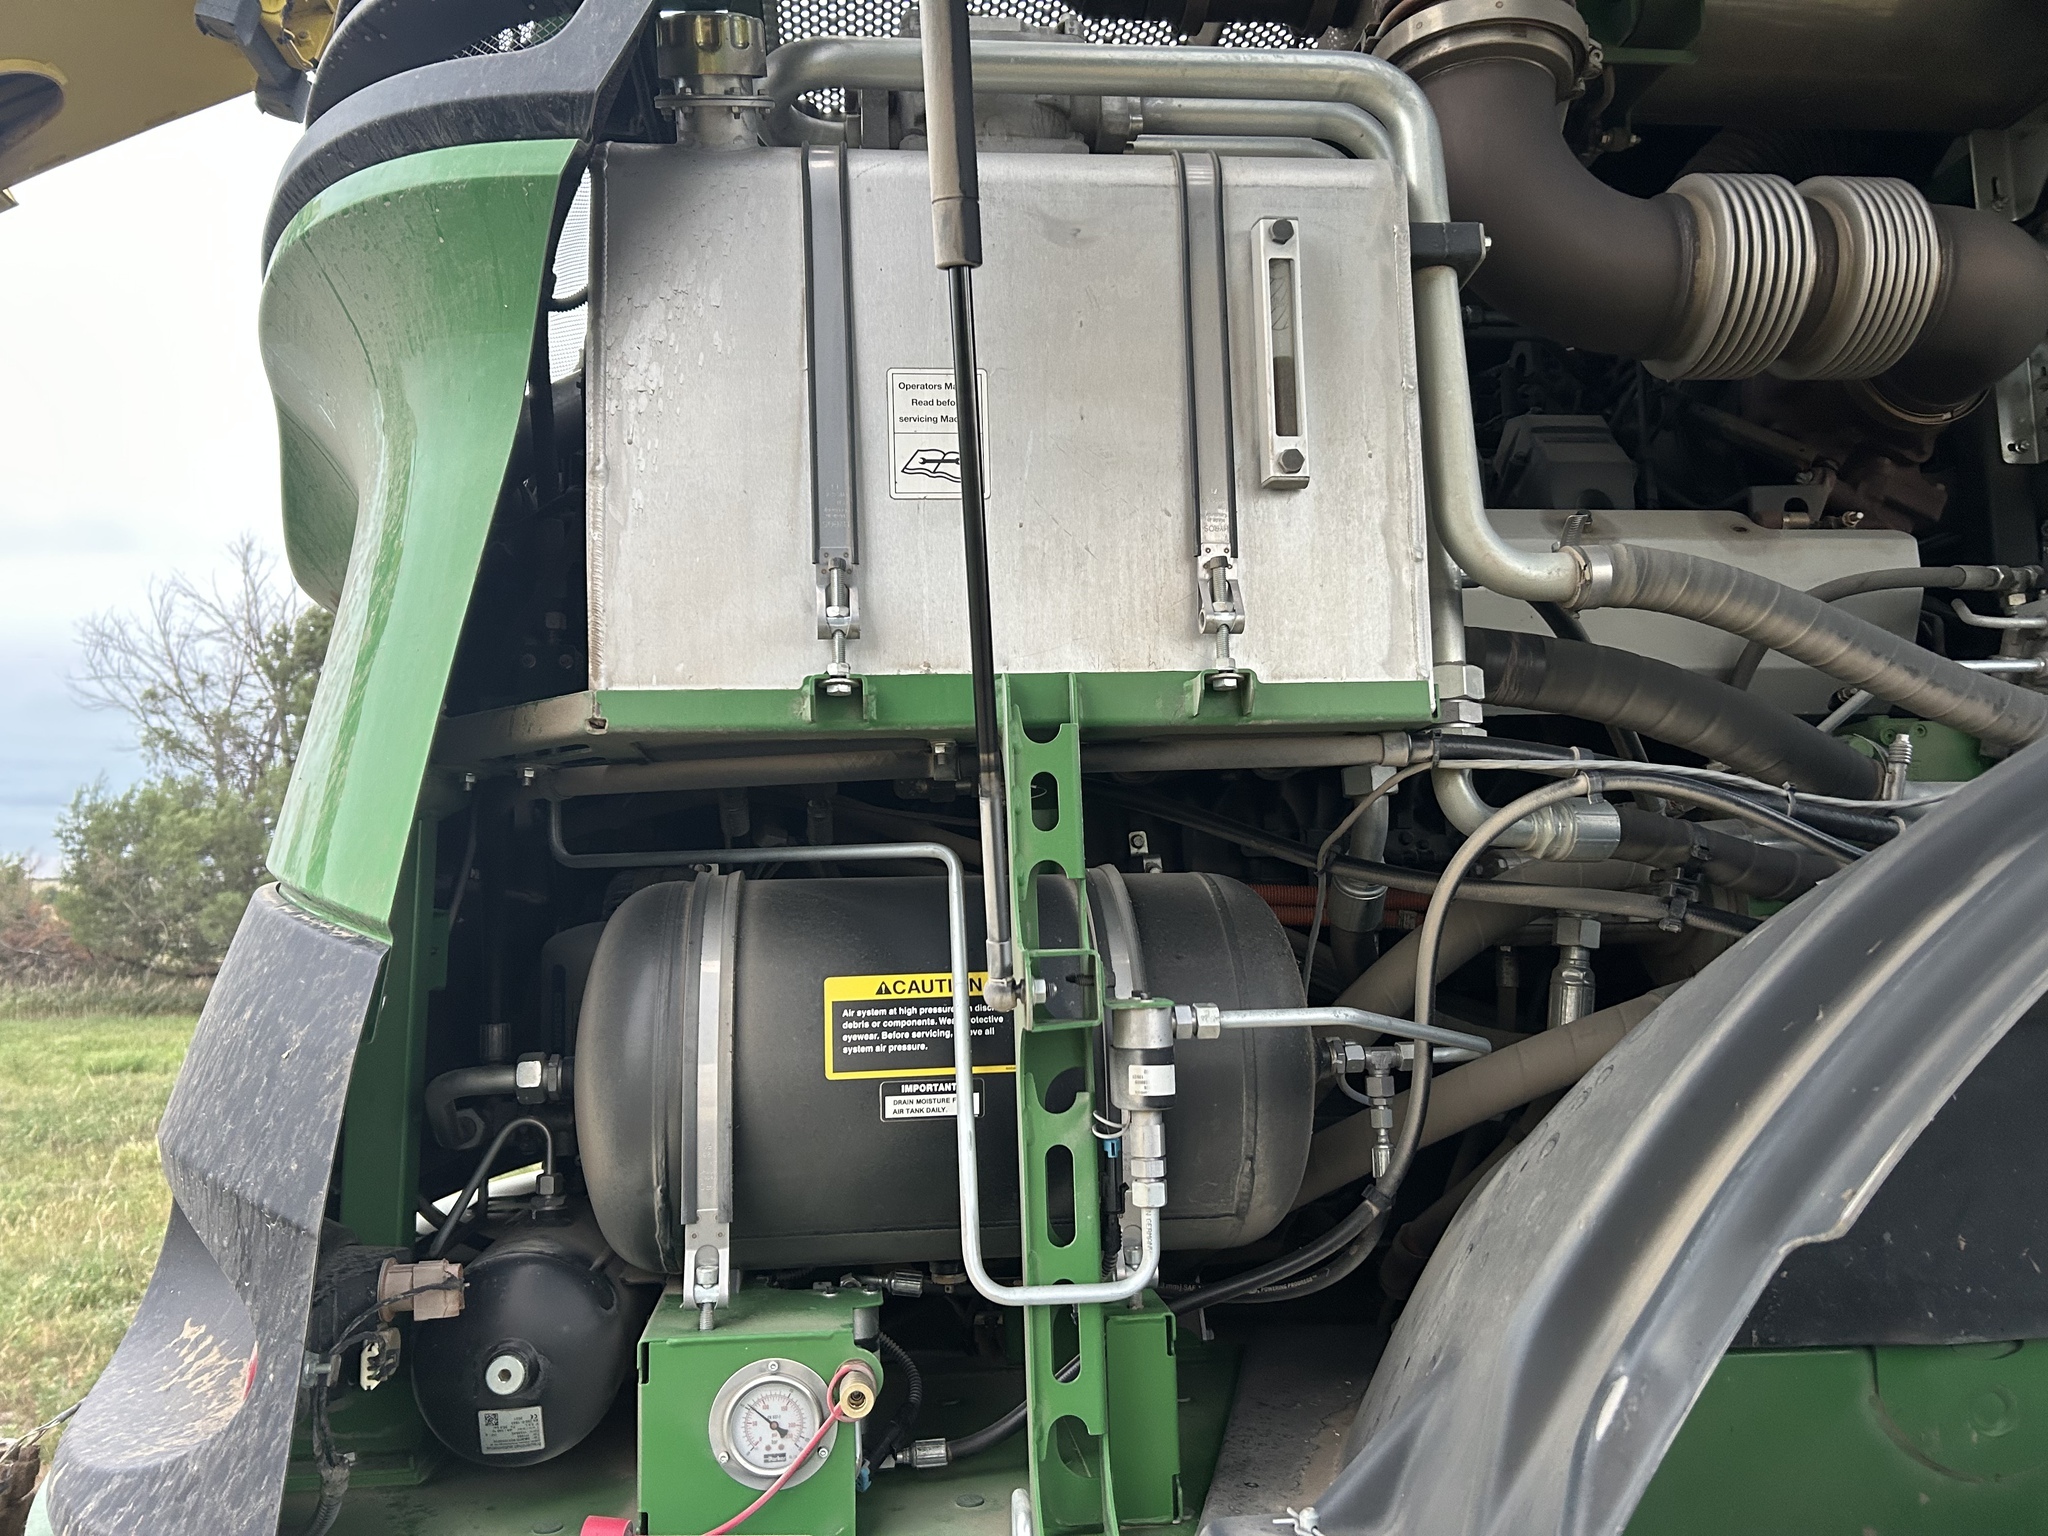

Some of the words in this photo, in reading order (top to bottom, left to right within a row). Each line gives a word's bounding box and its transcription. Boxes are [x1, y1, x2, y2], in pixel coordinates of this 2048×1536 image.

[898, 382, 942, 391] Operators
[911, 398, 934, 406] Read
[936, 398, 956, 406] befo
[899, 415, 938, 424] servicing
[892, 978, 982, 994] CAUTIN
[842, 1009, 855, 1017] Air
[856, 1008, 887, 1018] system
[888, 1007, 897, 1015] at
[899, 1006, 917, 1016] high
[842, 1020, 869, 1029] debris
[882, 1018, 937, 1028] components.
[970, 1015, 1004, 1024] otective
[842, 1033, 879, 1043] eyewear.
[881, 1031, 909, 1040] Before
[912, 1029, 953, 1039] servicing,
[985, 1027, 995, 1036] all
[843, 1045, 873, 1055] system
[875, 1044, 886, 1052] air
[888, 1043, 928, 1053] pressure.
